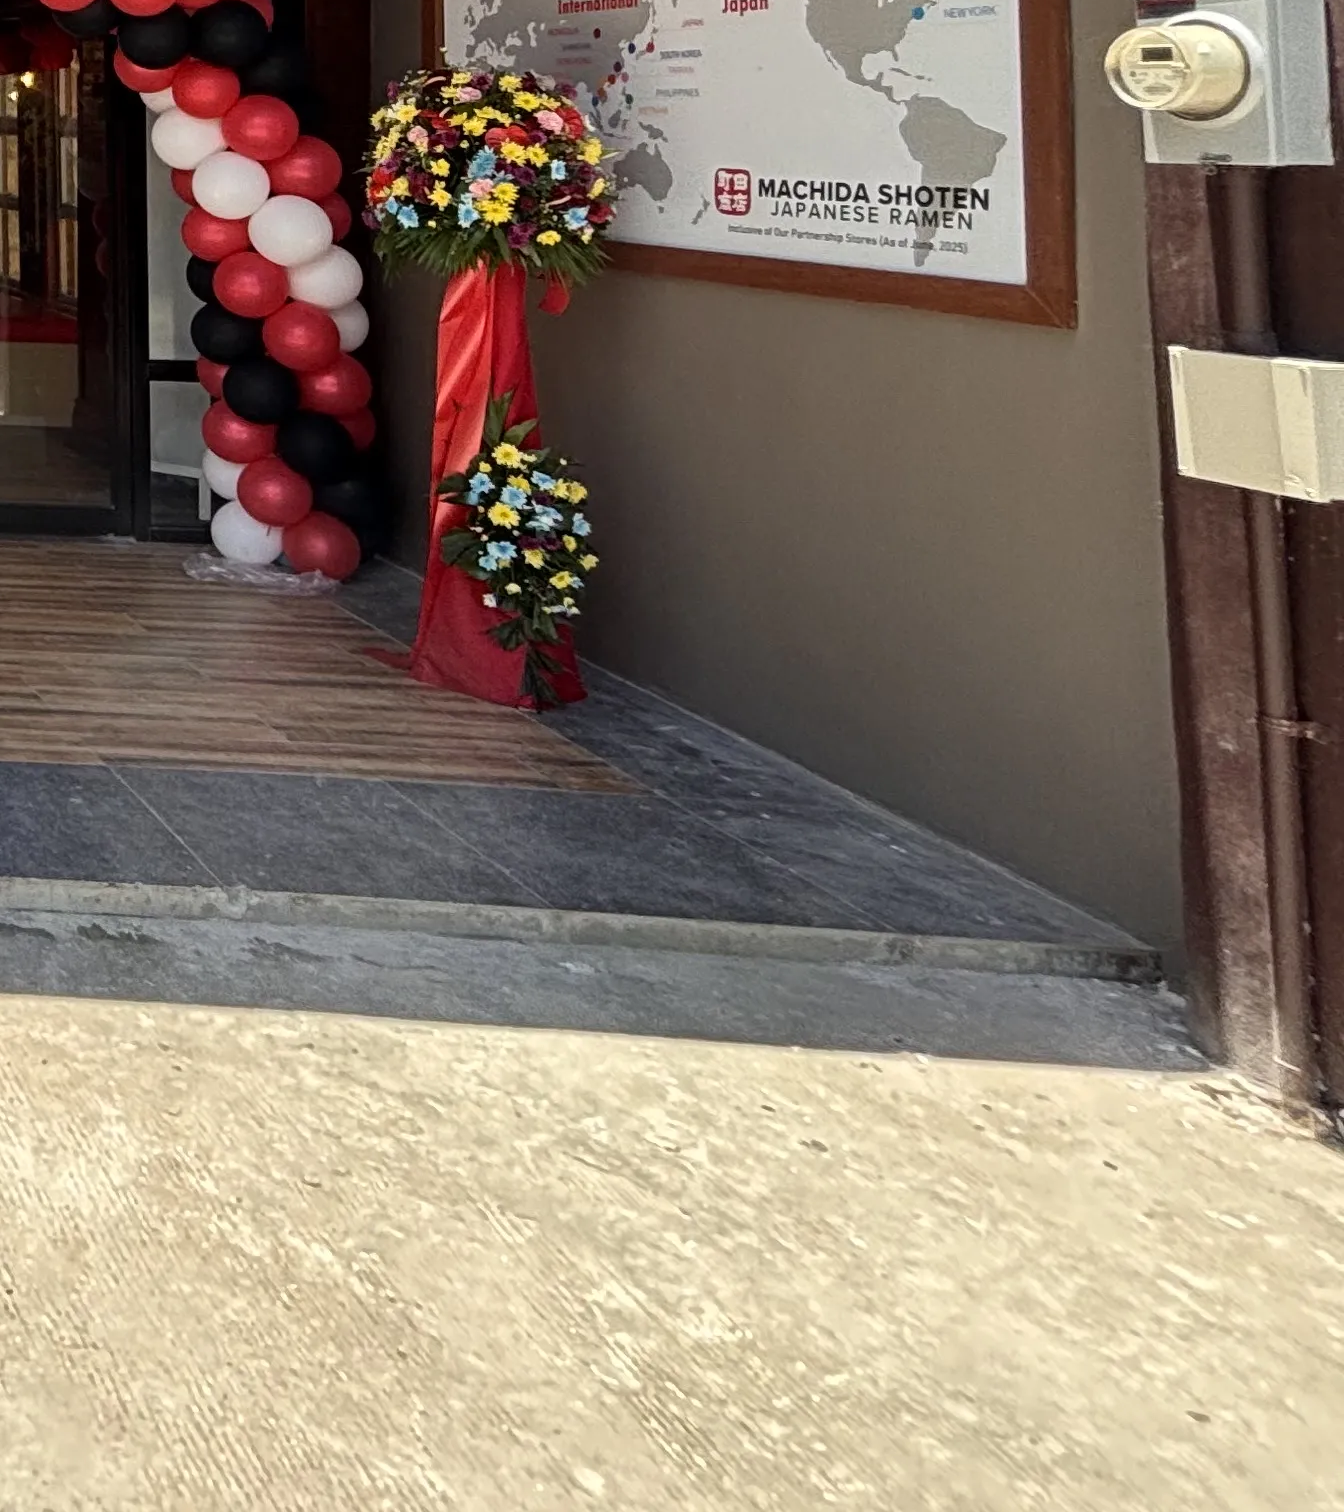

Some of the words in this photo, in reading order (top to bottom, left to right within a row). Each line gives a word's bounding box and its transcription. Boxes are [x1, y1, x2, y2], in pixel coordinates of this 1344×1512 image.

[758, 178, 871, 204] MACHIDA
[877, 183, 991, 212] SHOTEN
[770, 201, 880, 224] JAPANESE
[889, 208, 974, 231] RAMEN
[774, 227, 790, 238] Our
[845, 228, 878, 246] Stores
